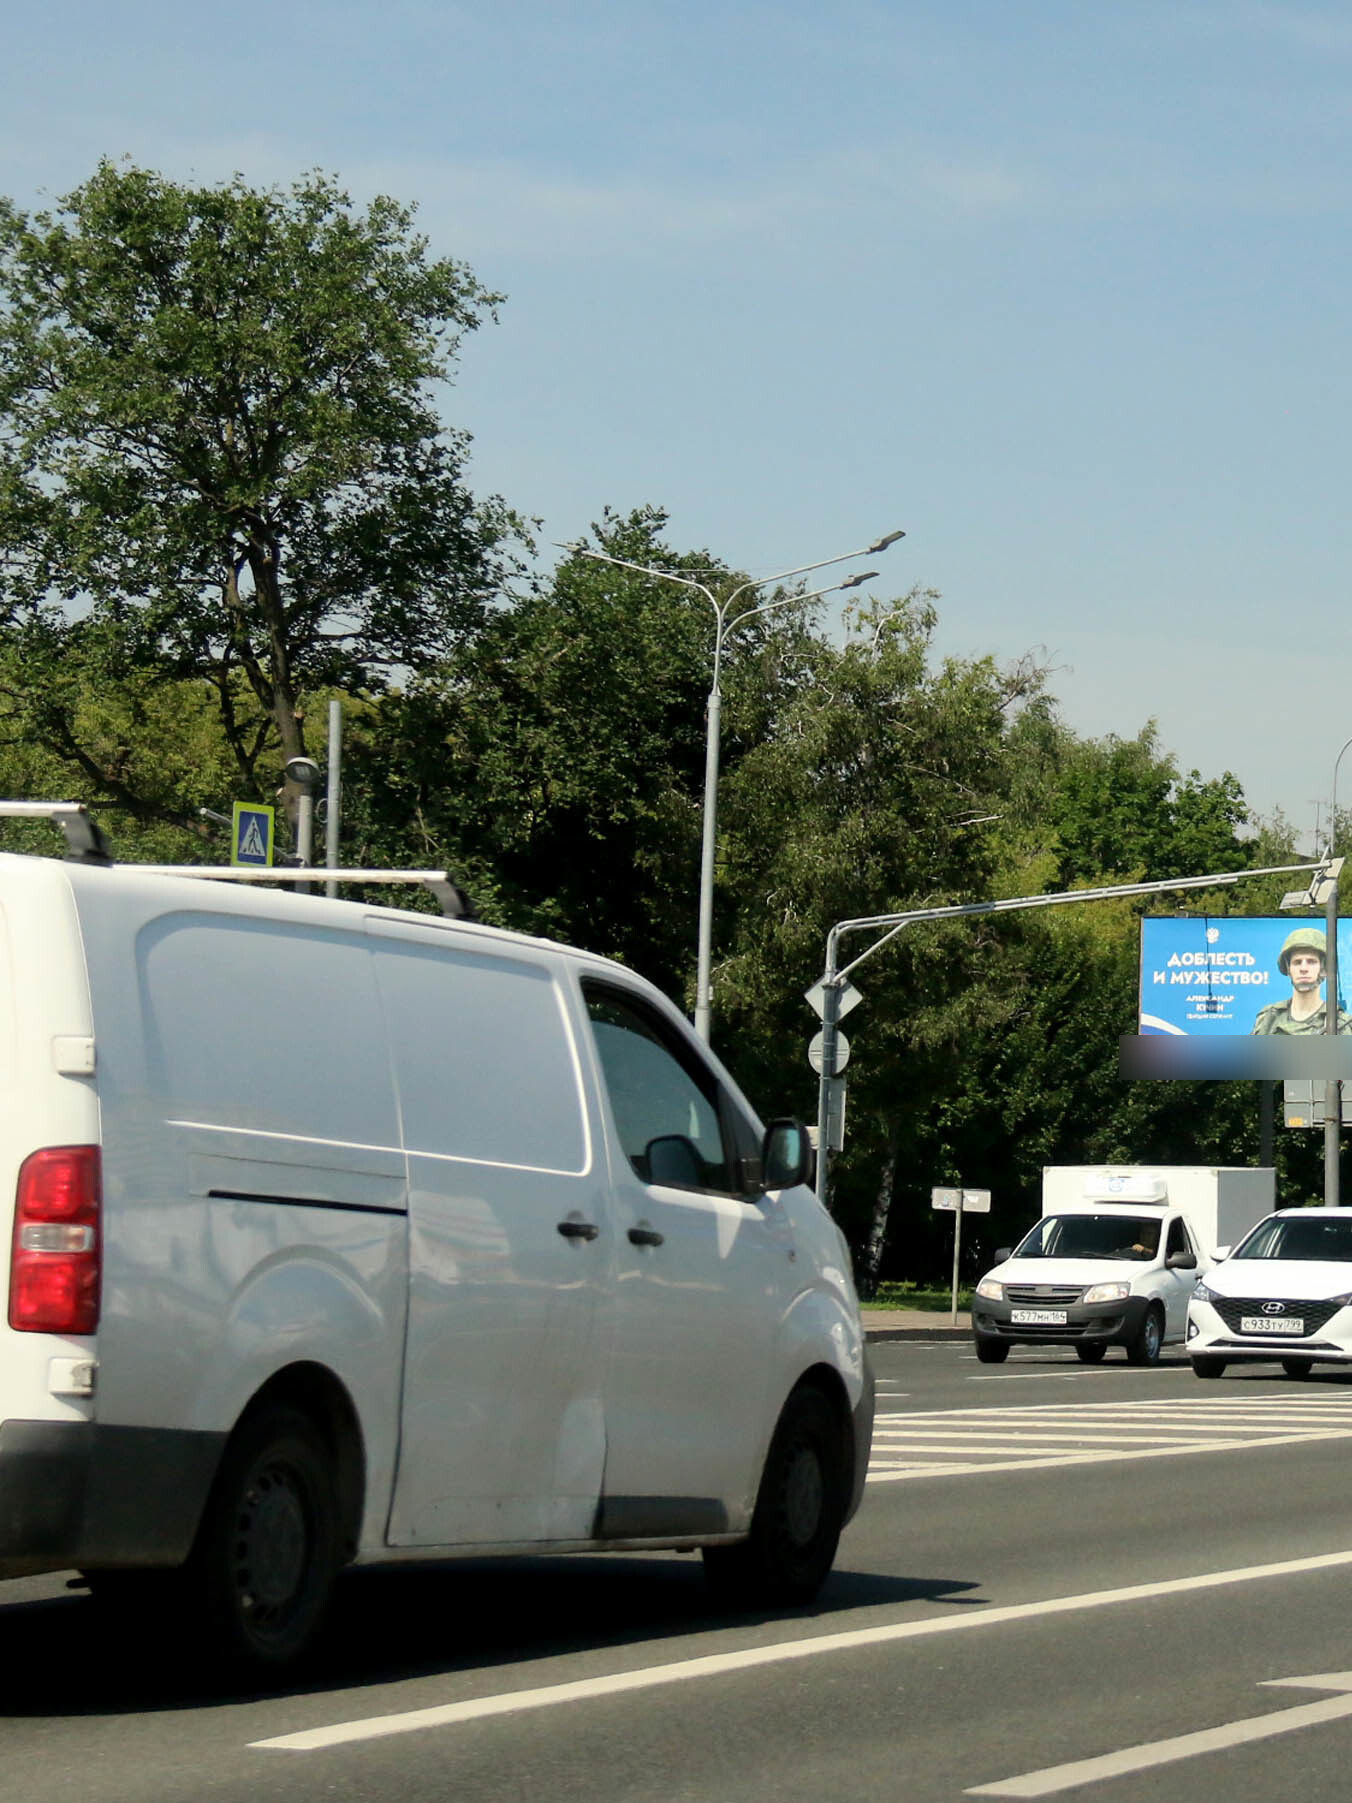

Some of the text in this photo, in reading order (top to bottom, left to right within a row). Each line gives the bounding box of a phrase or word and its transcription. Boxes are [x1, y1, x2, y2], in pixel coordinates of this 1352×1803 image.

[1167, 952, 1256, 967] ДОБЛЕСТЬ
[1153, 971, 1269, 985] И МУЖЕСТВО!
